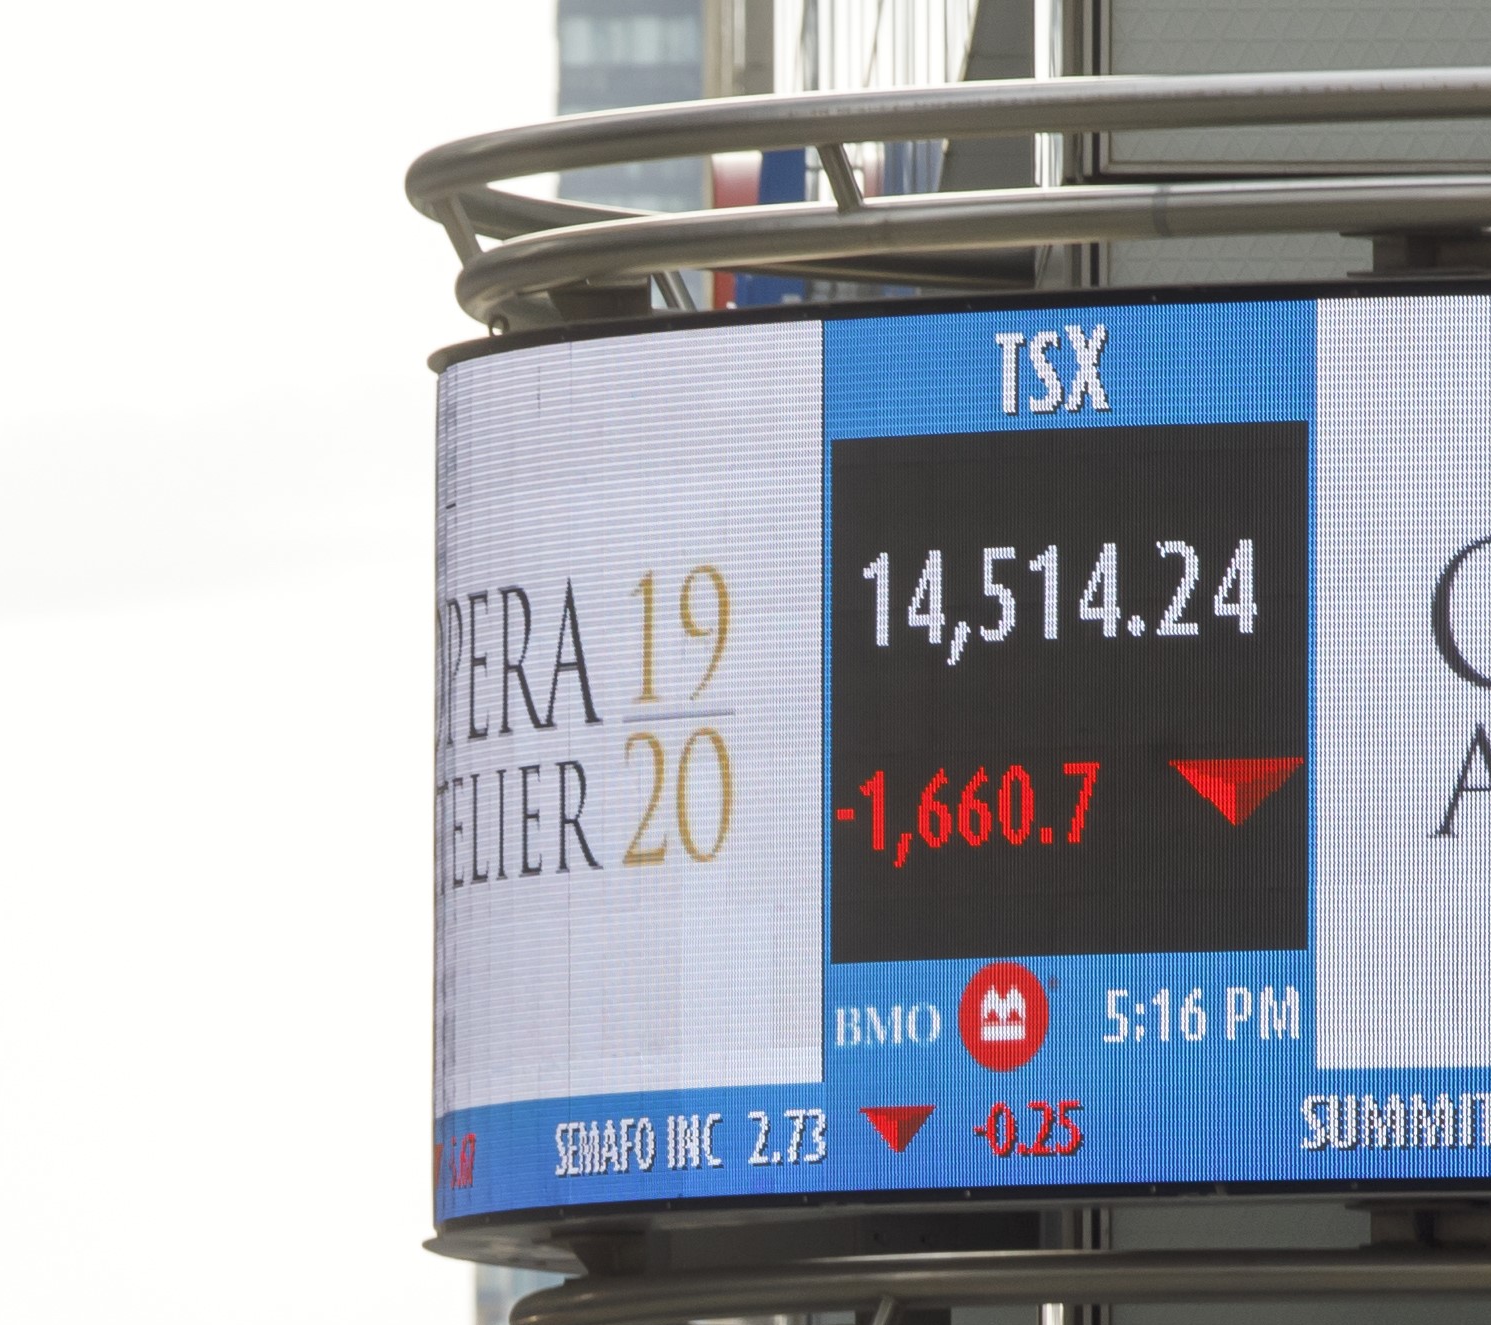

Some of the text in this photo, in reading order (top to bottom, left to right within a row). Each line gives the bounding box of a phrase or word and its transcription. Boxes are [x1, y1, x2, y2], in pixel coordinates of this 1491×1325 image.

[995, 323, 1112, 416] TSX
[630, 563, 732, 703] 19
[862, 537, 1260, 666] 14,514.24
[622, 727, 734, 866] 20
[836, 760, 1101, 869] -1,660.7
[833, 1001, 942, 1047] BMO
[1102, 984, 1303, 1044] 5:16 PM
[554, 1107, 829, 1178] SEMAFO INC 2.73
[972, 1099, 1084, 1158] -0.25
